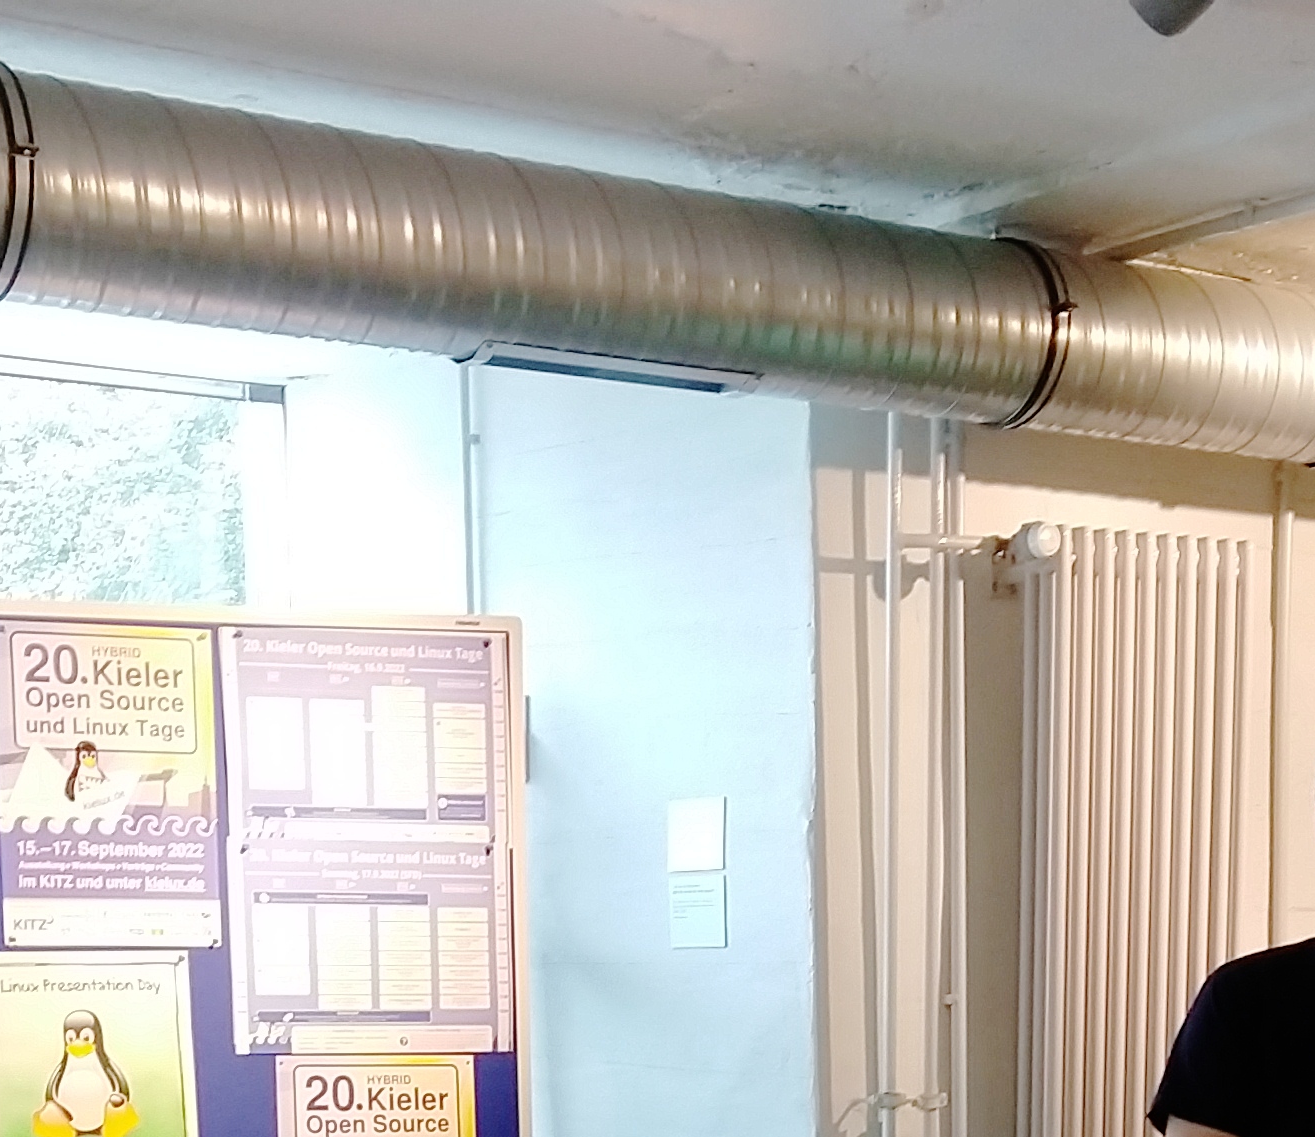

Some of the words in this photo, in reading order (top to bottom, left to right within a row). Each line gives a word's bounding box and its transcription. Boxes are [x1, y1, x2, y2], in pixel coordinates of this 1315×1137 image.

[92, 646, 141, 658] HYBRID
[391, 645, 415, 657] und
[418, 646, 452, 659] Linux
[455, 647, 483, 663] Tage
[23, 642, 88, 685] 20.
[93, 659, 183, 688] Kieler
[25, 686, 90, 713] Open
[100, 689, 184, 712] Source
[26, 717, 65, 734] und
[73, 717, 129, 736] Linux
[136, 719, 185, 741] Tage
[77, 840, 165, 861] September
[167, 842, 205, 858] 2022
[423, 851, 456, 864] Linux
[459, 852, 486, 869] Tage
[39, 874, 74, 889] KITZ
[76, 875, 103, 889] und
[105, 876, 142, 890] unter
[0, 978, 39, 993] Linux
[43, 978, 134, 992] Presentation
[137, 978, 161, 995] Day
[367, 1075, 412, 1084] HYBRID
[305, 1075, 364, 1112] 20.
[367, 1087, 449, 1111] Kieler
[373, 1114, 450, 1133] Source
